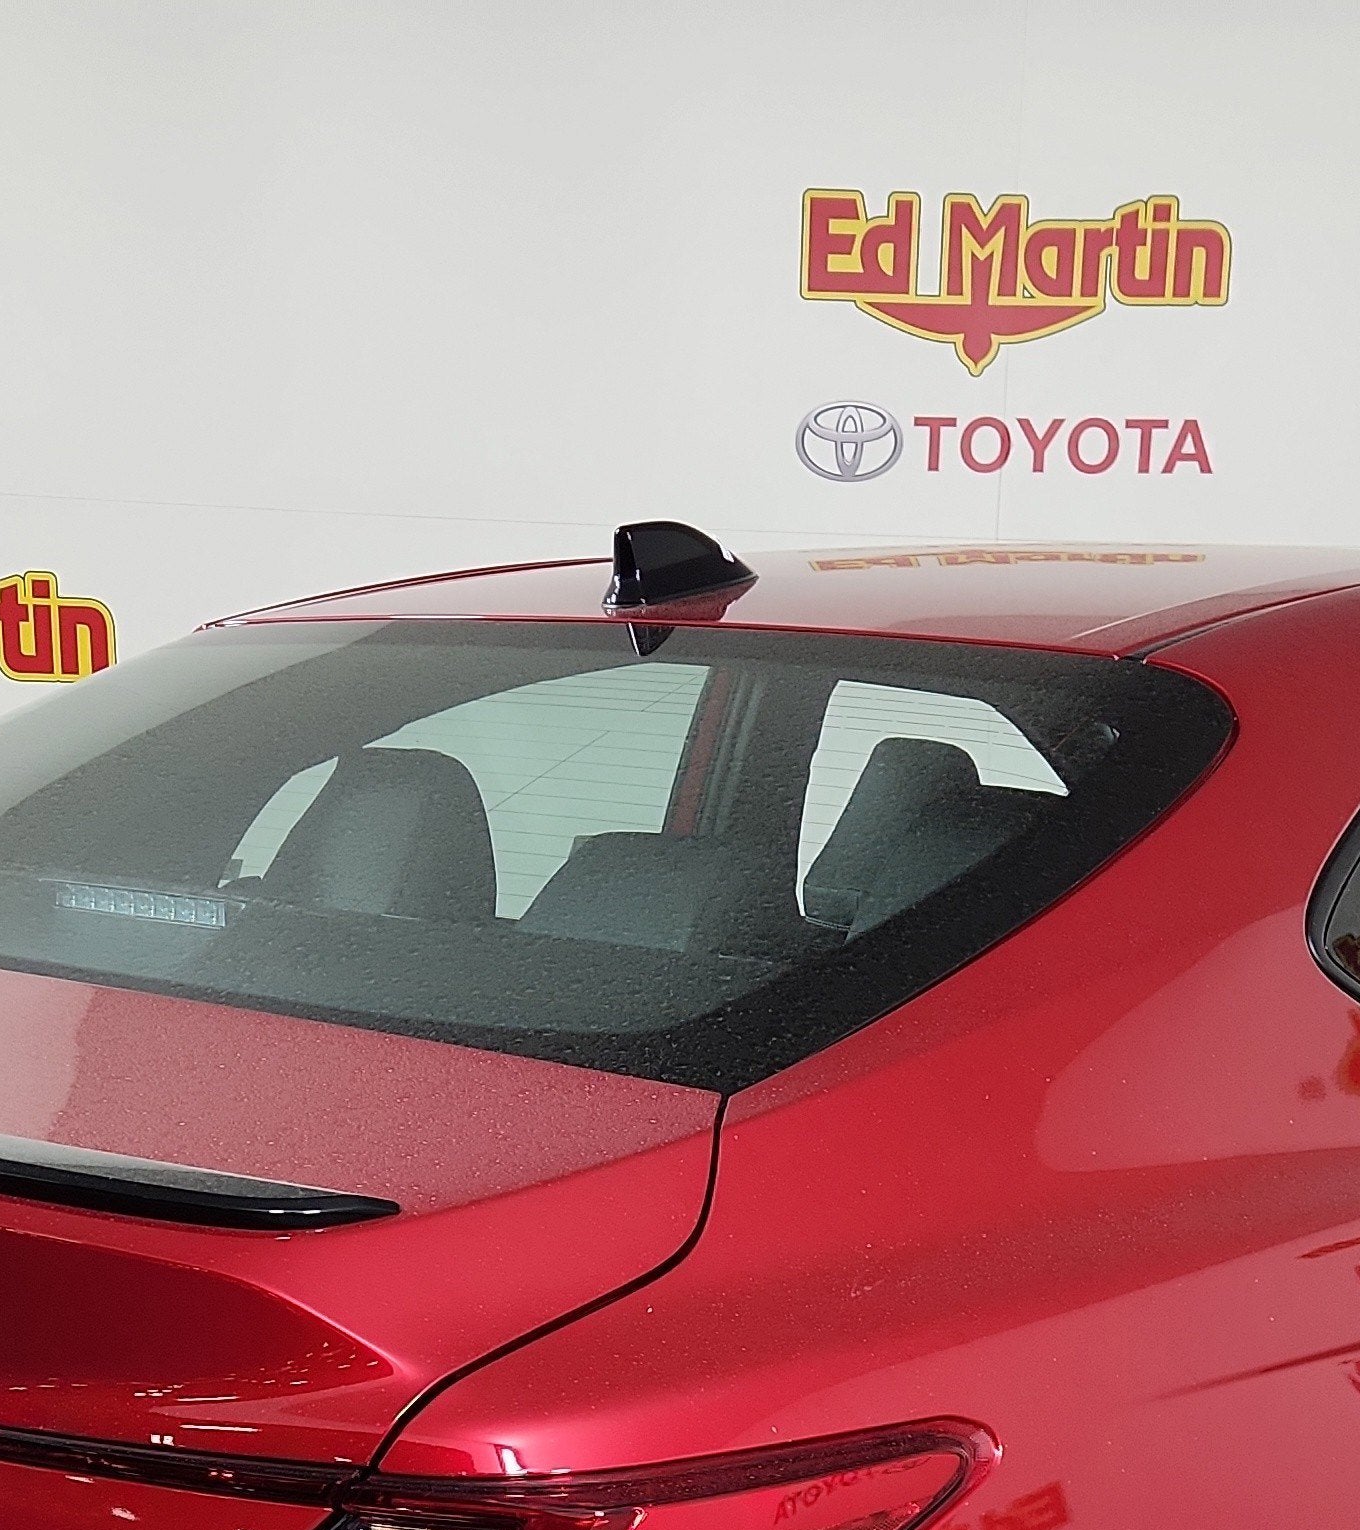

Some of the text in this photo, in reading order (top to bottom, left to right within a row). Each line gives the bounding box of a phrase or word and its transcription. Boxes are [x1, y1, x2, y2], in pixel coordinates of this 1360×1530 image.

[803, 190, 1230, 304] Ed Martin
[914, 417, 1213, 474] TOYOTA
